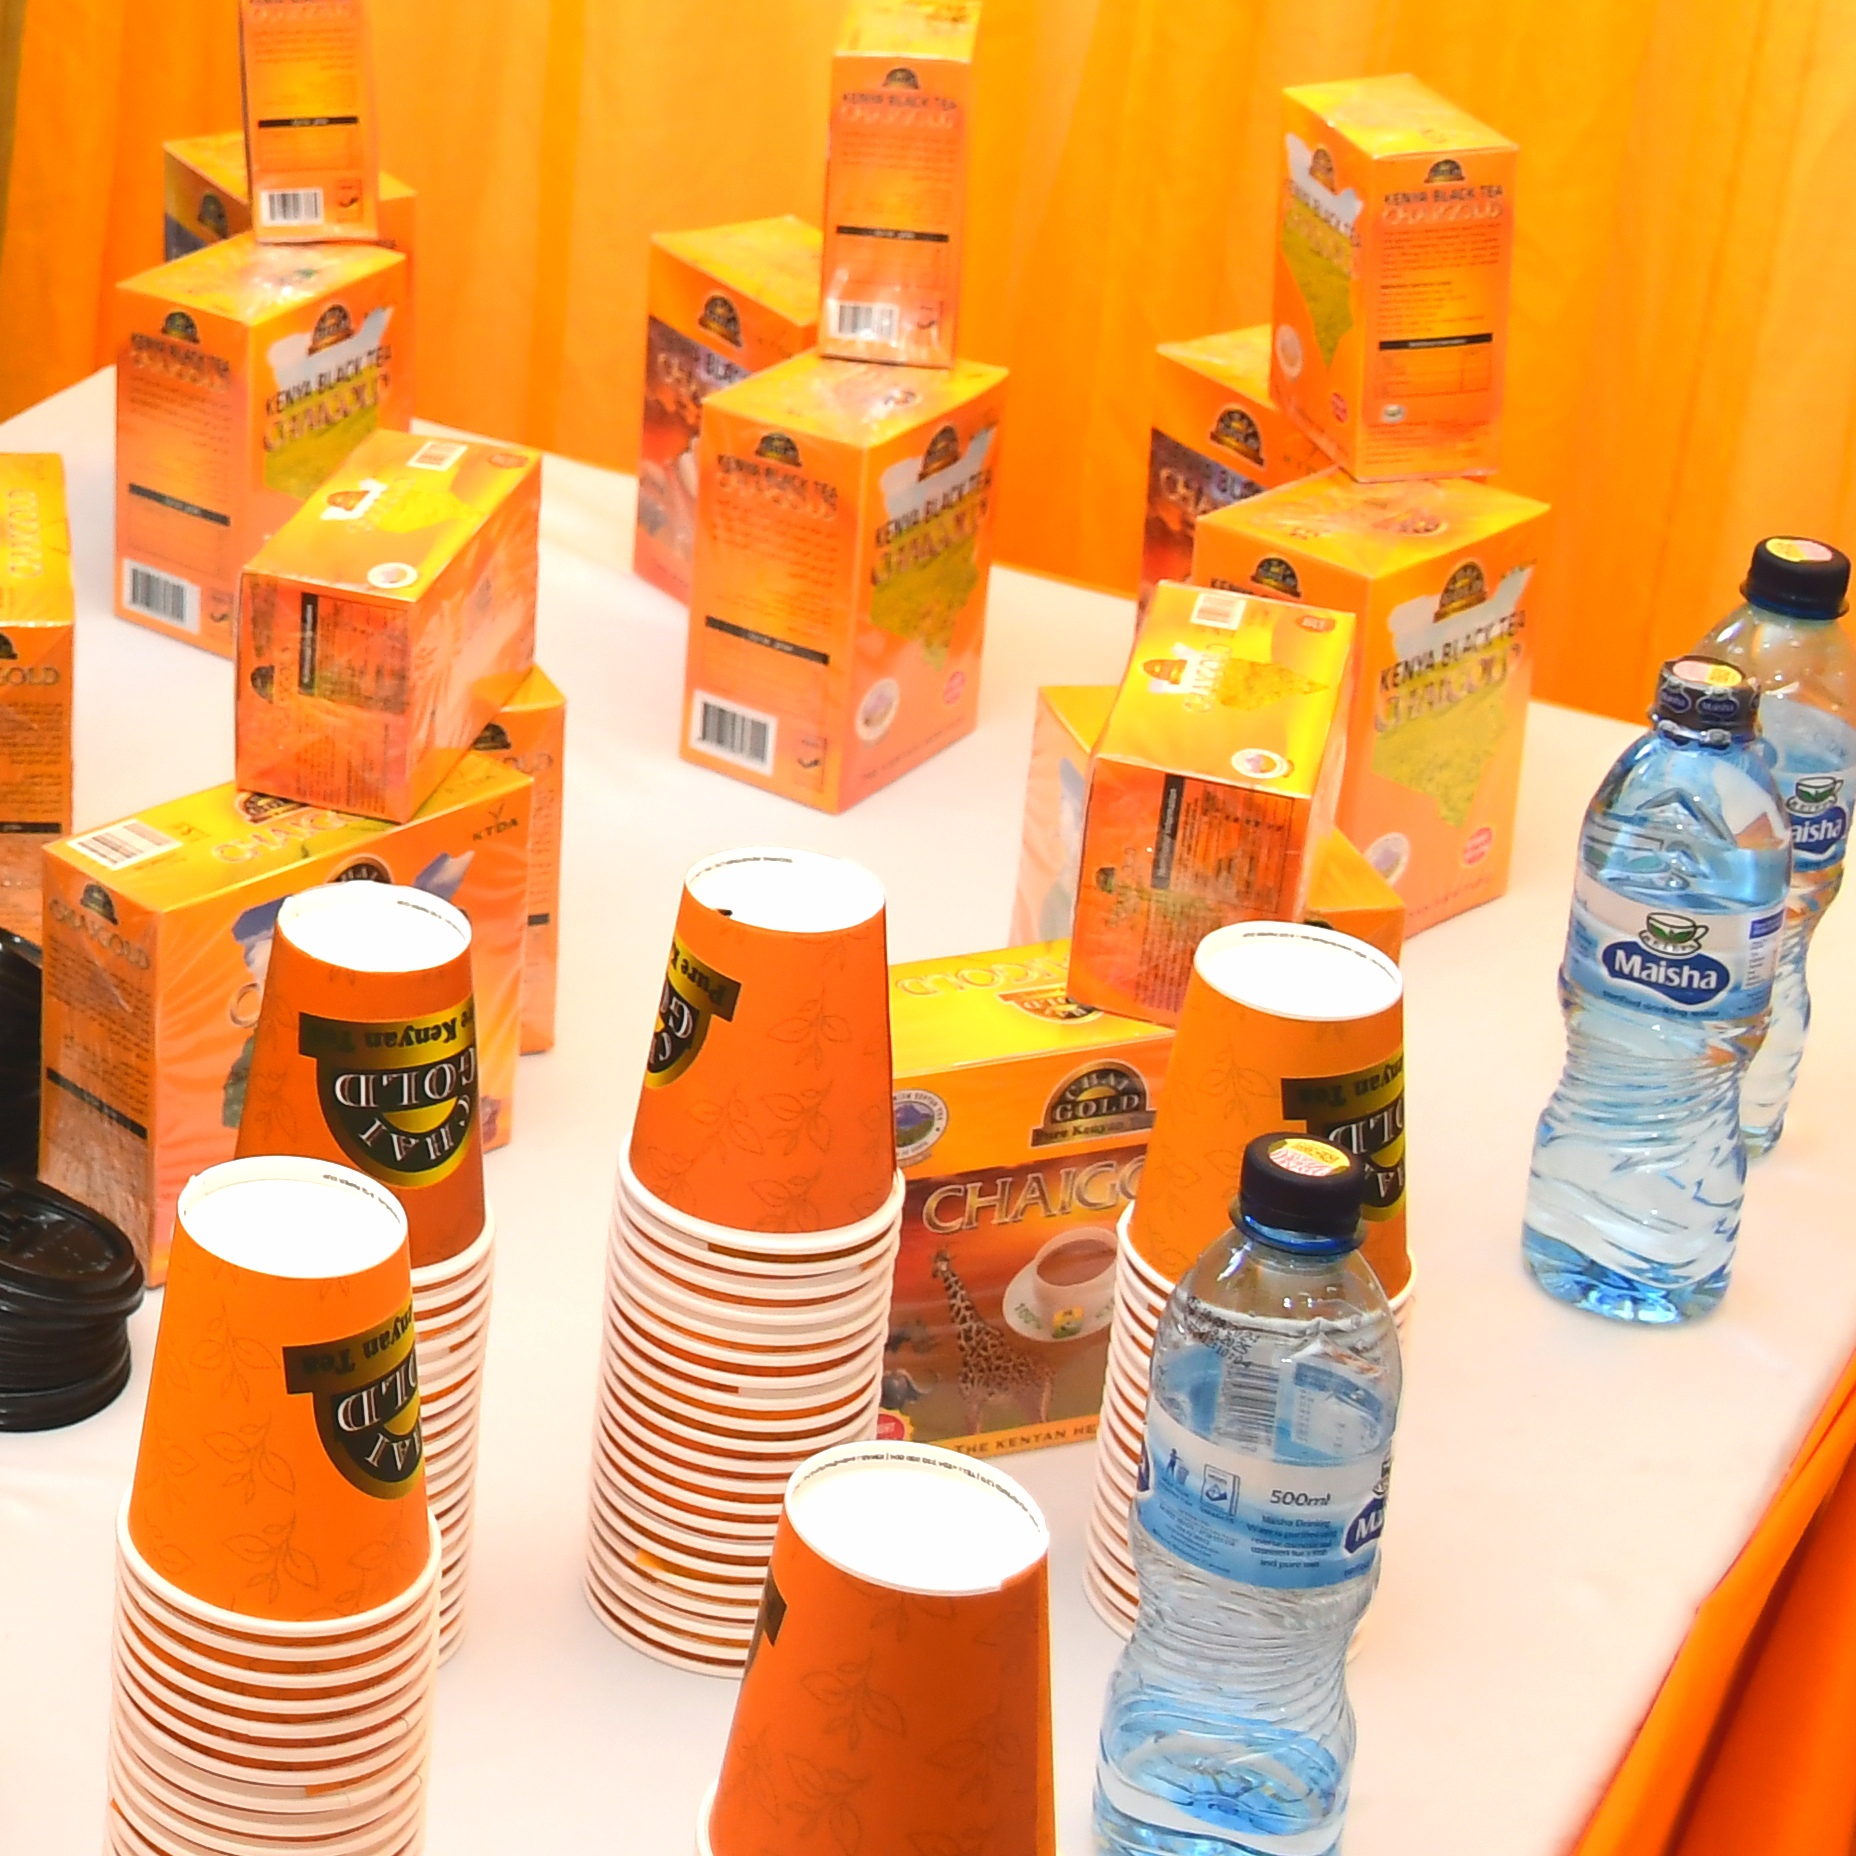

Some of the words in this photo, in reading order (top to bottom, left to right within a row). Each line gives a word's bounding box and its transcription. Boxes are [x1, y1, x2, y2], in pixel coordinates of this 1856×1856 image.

[472, 816, 519, 842] KTDA
[1791, 818, 1844, 844] aisha
[1614, 948, 1718, 990] Maisha
[365, 1016, 458, 1050] Kenyan
[334, 1047, 475, 1108] GOLD
[1064, 1071, 1133, 1101] CHAI
[1054, 1094, 1140, 1125] GOLD
[358, 1093, 472, 1163] CHAI
[922, 1154, 1145, 1234] CHAIGO
[953, 1442, 990, 1458] THE
[1269, 1488, 1332, 1507] 500ml
